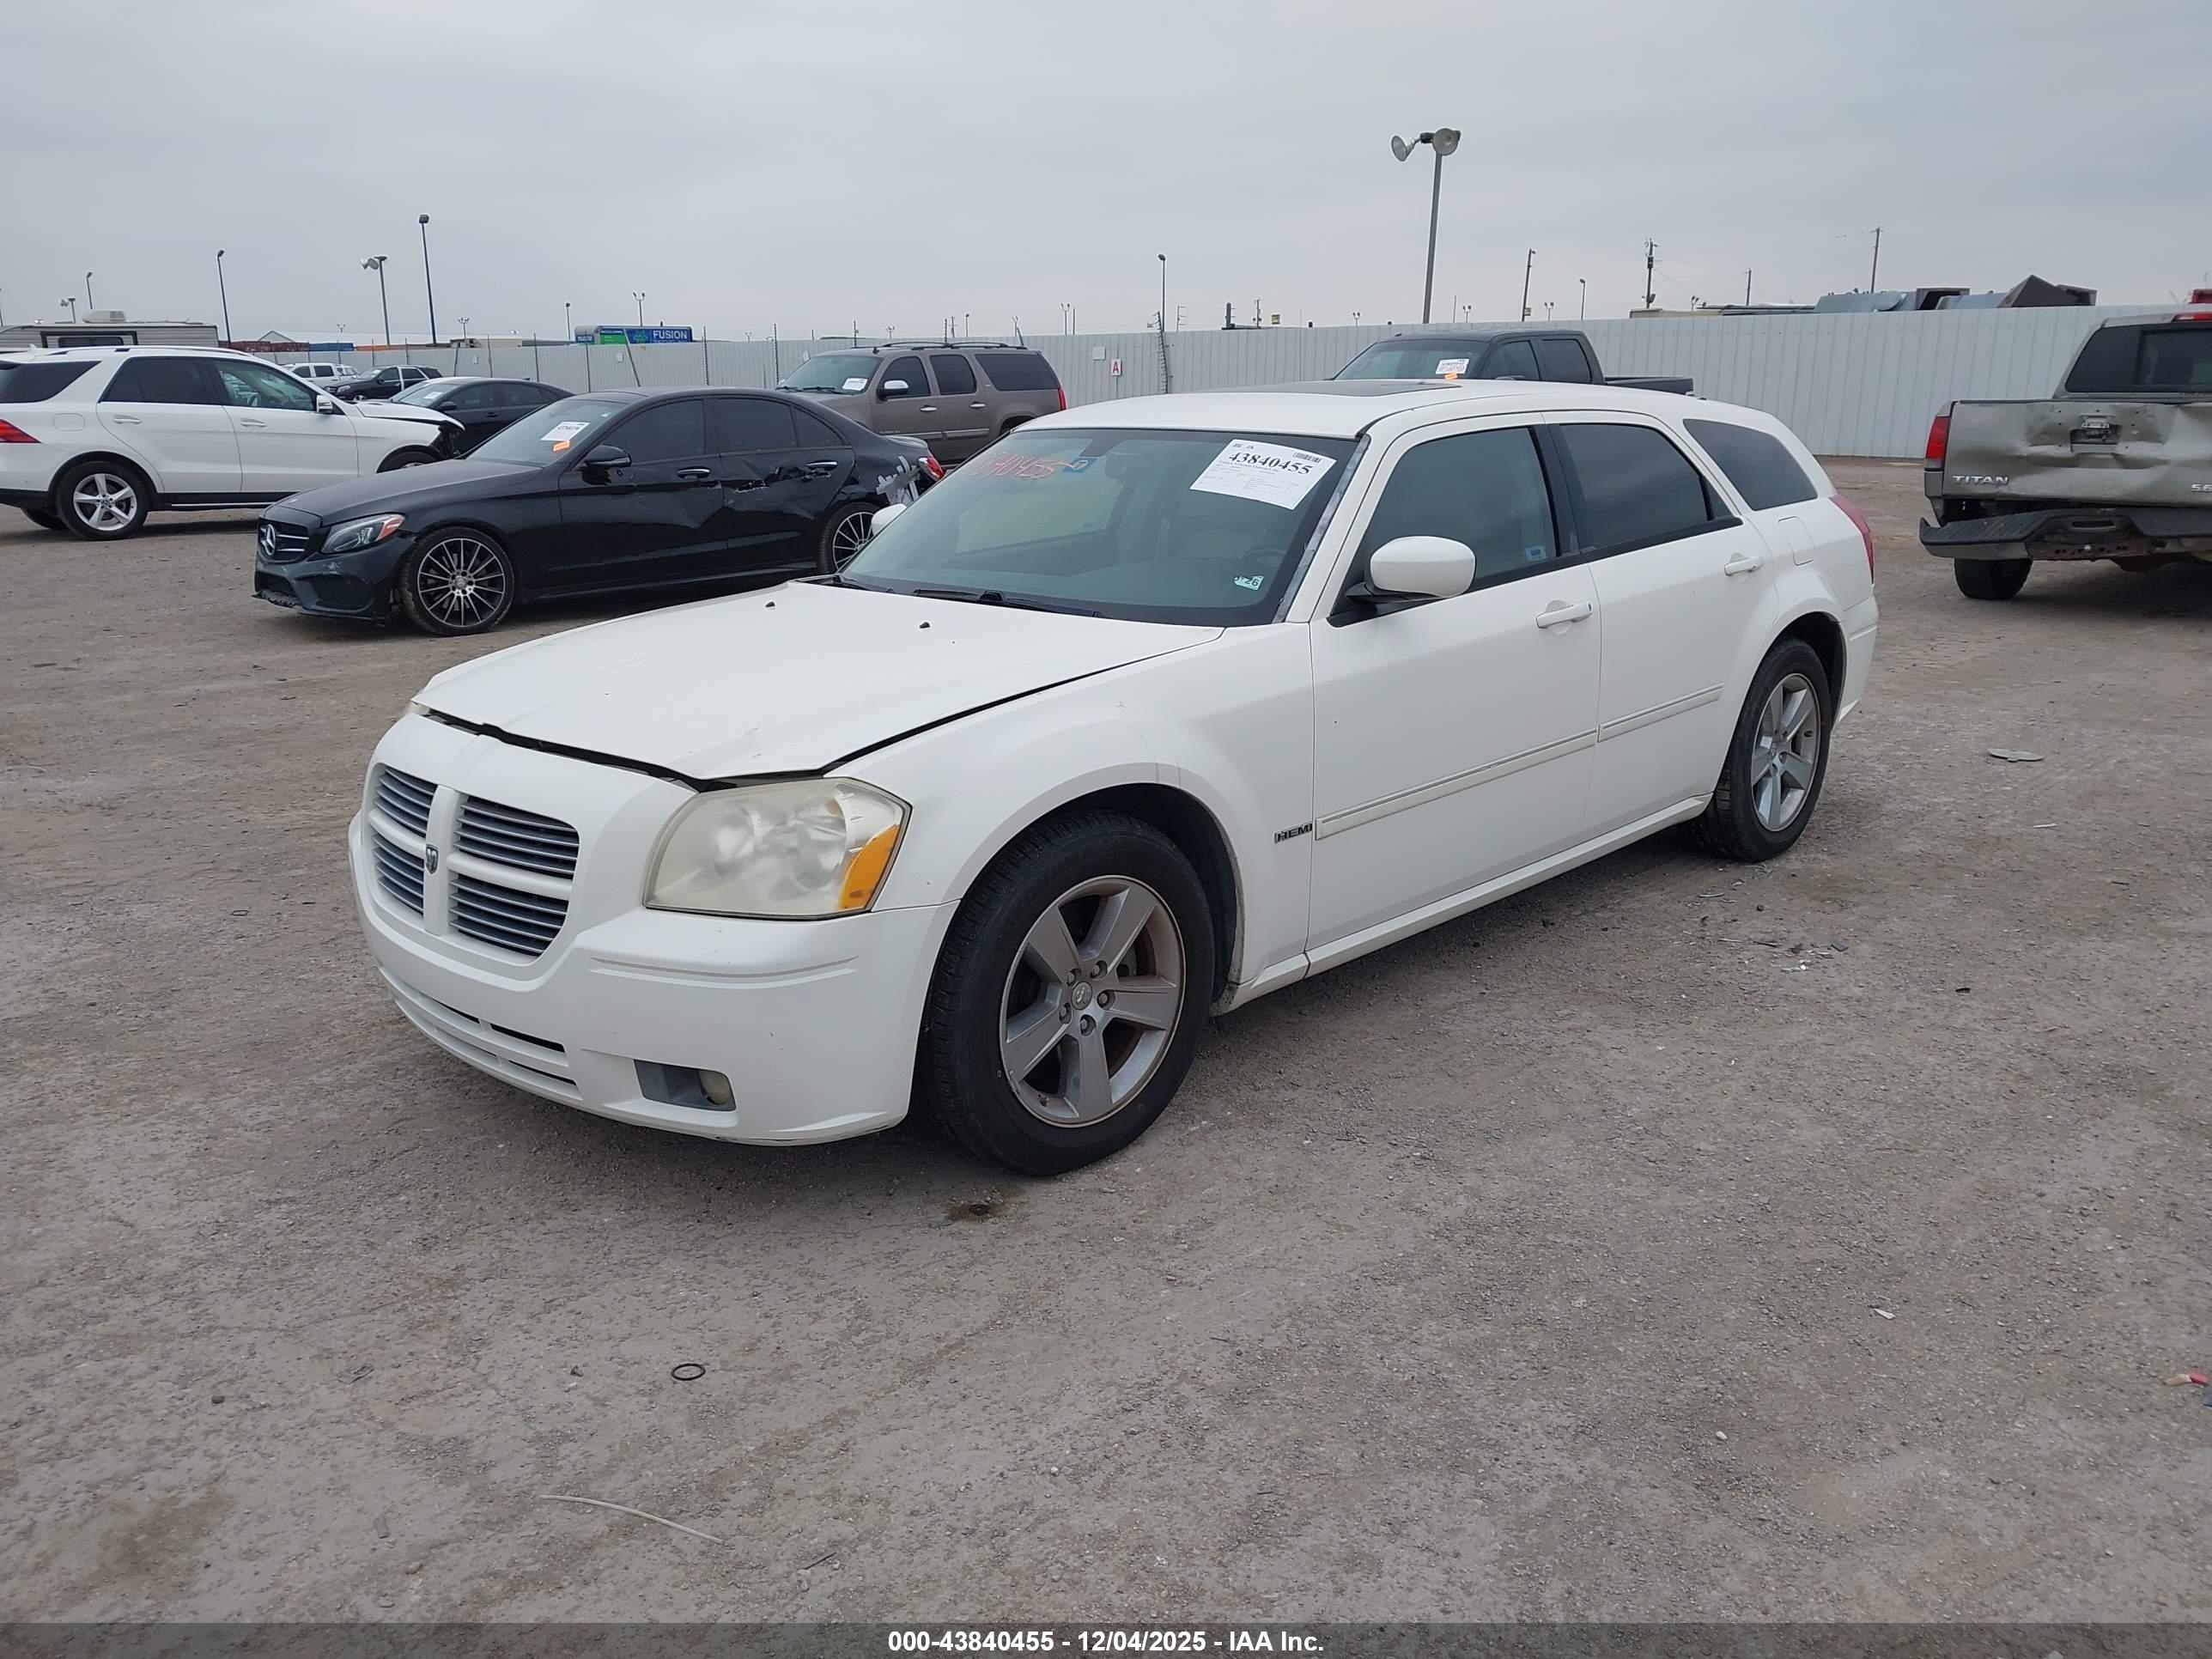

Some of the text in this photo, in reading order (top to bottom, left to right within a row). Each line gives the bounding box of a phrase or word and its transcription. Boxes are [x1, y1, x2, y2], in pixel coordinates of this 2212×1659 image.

[653, 330, 687, 339] FUSION
[1112, 361, 1120, 374] A
[1229, 452, 1314, 475] 43840455
[1952, 475, 2008, 485] TITAN
[1277, 823, 1313, 842] HEMI
